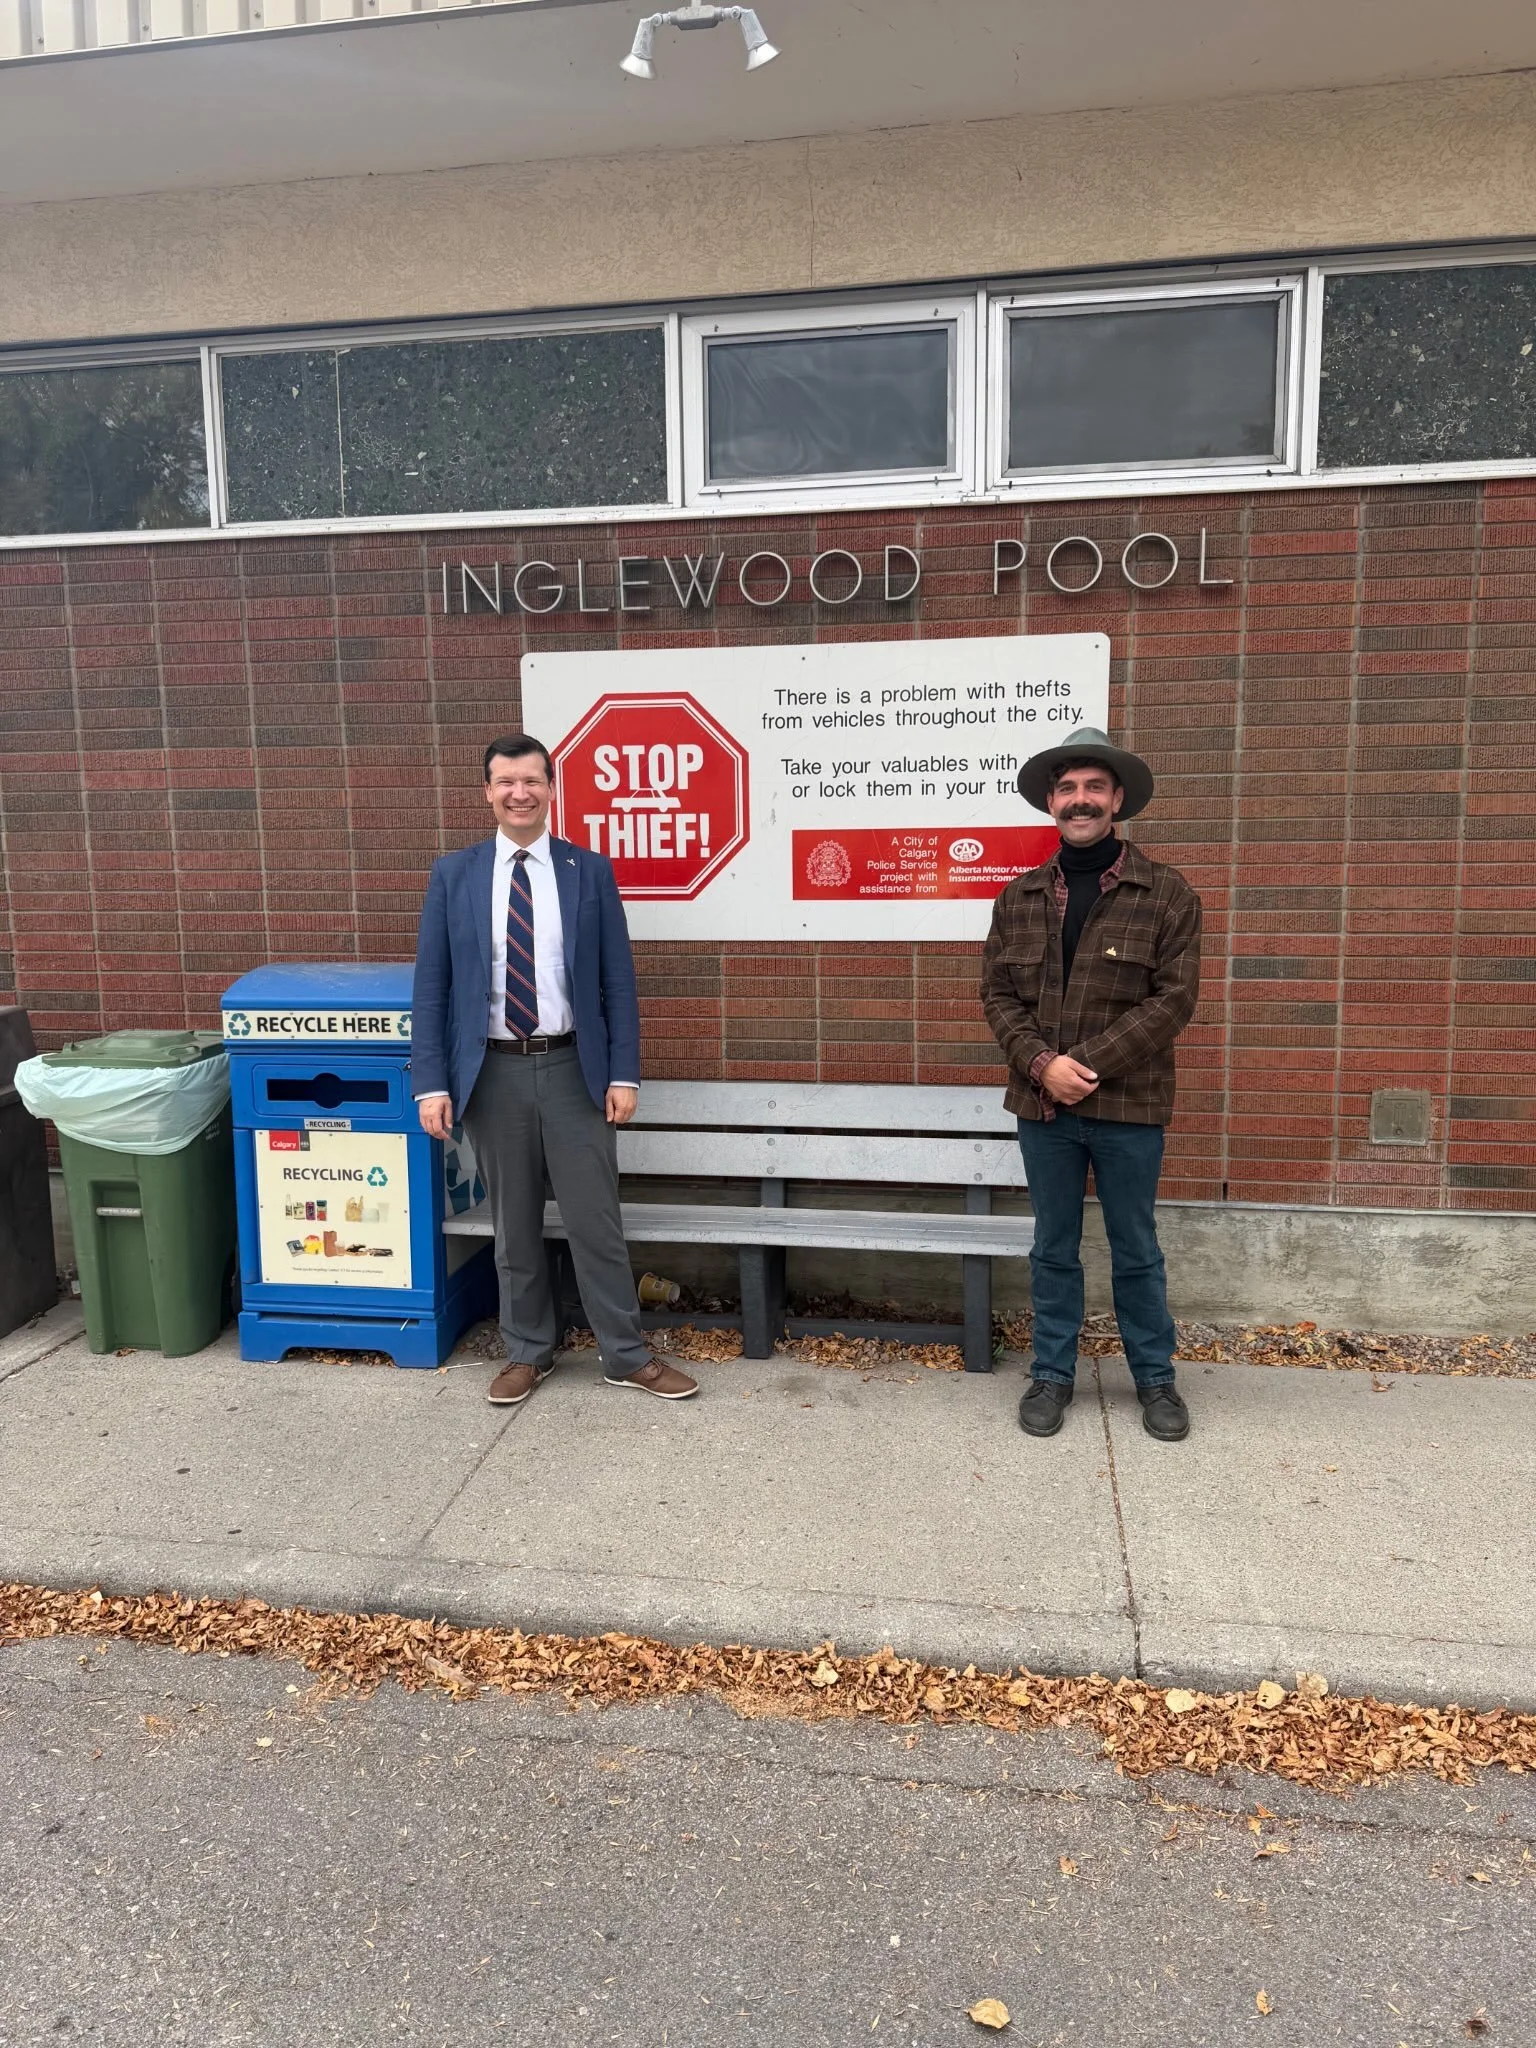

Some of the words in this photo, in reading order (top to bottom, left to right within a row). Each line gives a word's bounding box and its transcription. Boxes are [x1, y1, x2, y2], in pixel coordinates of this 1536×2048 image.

[443, 544, 921, 613] INGLEWOOD
[993, 527, 1235, 595] POOL
[774, 688, 827, 706] There
[836, 688, 851, 704] is
[860, 691, 872, 704] a
[881, 685, 957, 707] problem
[967, 682, 1006, 701] with
[1015, 680, 1071, 699] thefts
[762, 712, 803, 729] from
[812, 710, 886, 729] vehicles
[896, 706, 997, 729] throughout
[1007, 705, 1037, 723] the
[1047, 704, 1085, 725] city.
[594, 743, 704, 791] STOP
[781, 758, 822, 776] Take
[832, 760, 871, 779] your
[881, 756, 969, 774] valuables
[979, 753, 1018, 770] with
[792, 783, 810, 798] or
[819, 780, 856, 797] lock
[867, 779, 912, 797] them
[921, 778, 936, 795] in
[946, 779, 986, 799] your
[996, 778, 1019, 794] tru
[583, 812, 711, 859] THIEF!
[891, 836, 899, 846] A
[903, 836, 923, 848] City
[928, 835, 938, 846] of
[899, 847, 938, 860] Calgary
[867, 860, 896, 870] Police
[900, 860, 938, 870] Service
[948, 865, 981, 873] Alberta
[983, 865, 1010, 873] Motor
[880, 872, 913, 884] project
[917, 871, 938, 882] with
[949, 875, 992, 883] Insurance
[859, 883, 911, 894] assistance
[915, 883, 938, 893] from
[257, 1016, 338, 1032] RECYCLE
[343, 1017, 392, 1033] HERE
[272, 1141, 297, 1149] Calgary
[283, 1167, 364, 1182] RECYCLING
